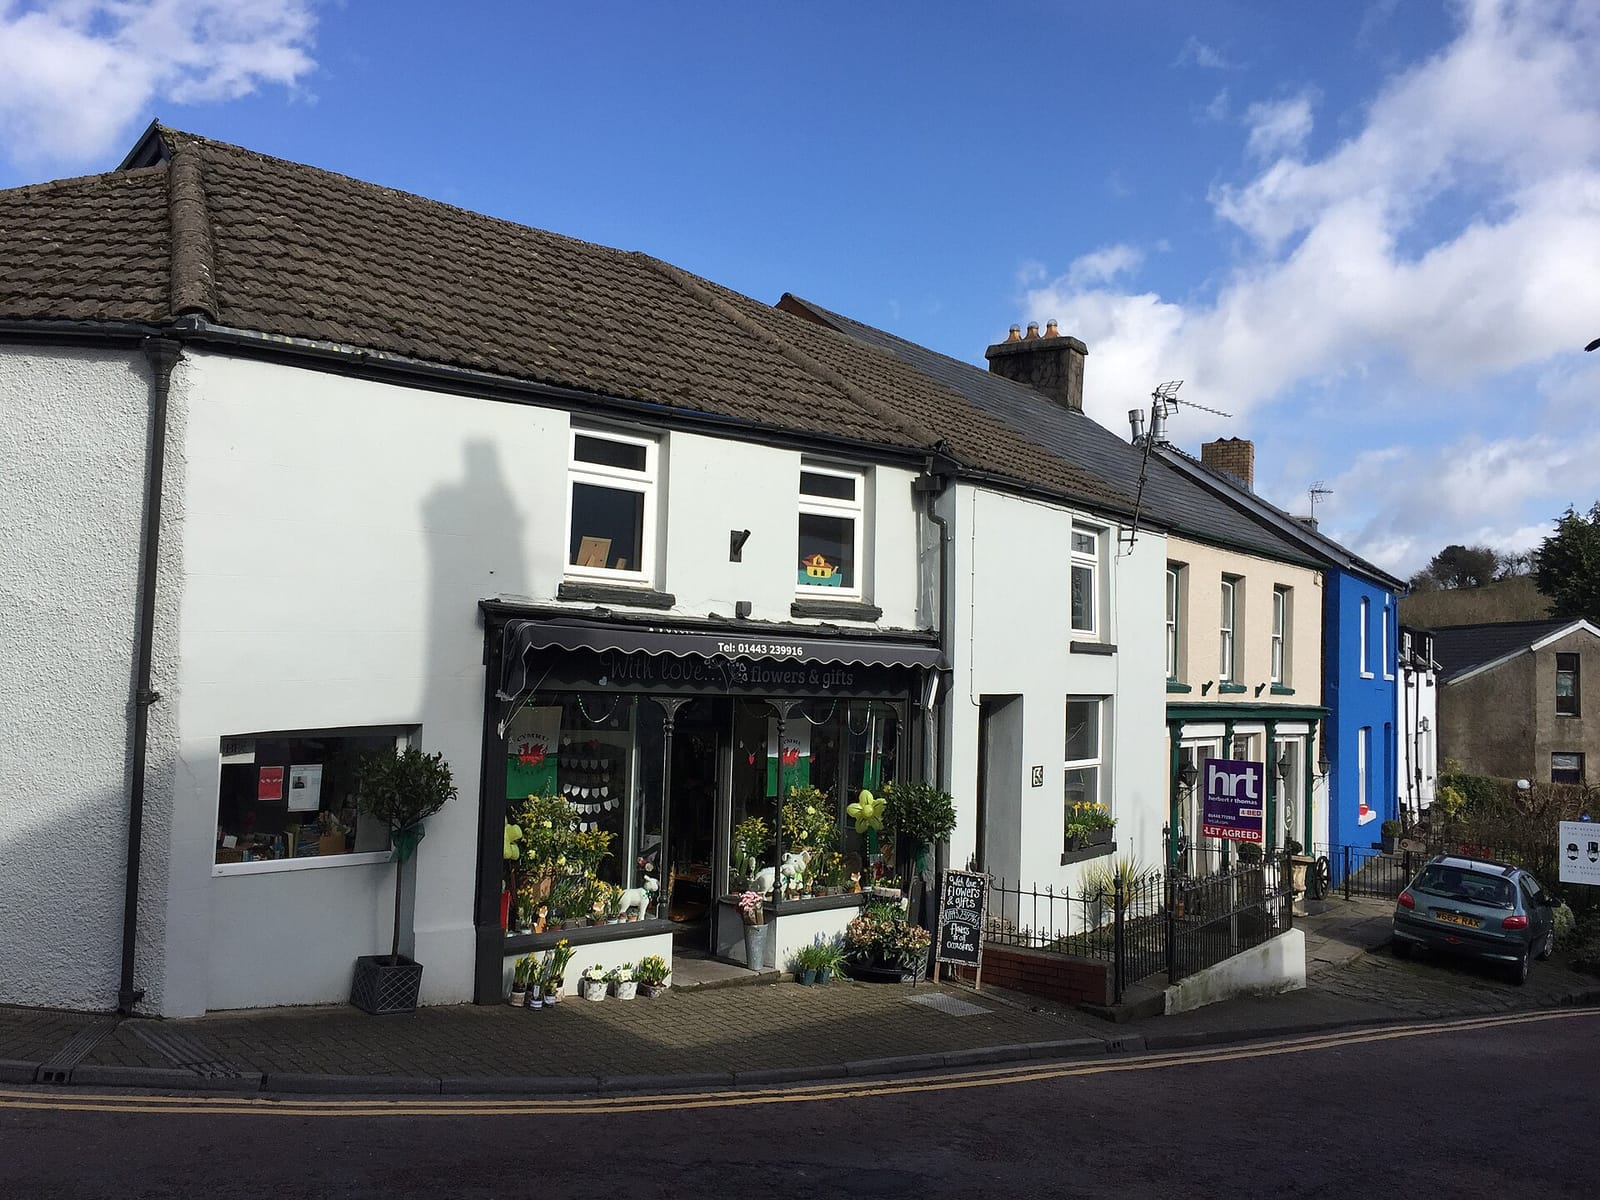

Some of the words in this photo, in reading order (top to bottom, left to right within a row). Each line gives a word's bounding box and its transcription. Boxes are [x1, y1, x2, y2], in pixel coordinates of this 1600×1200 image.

[718, 642, 736, 653] Tel:
[738, 643, 767, 654] 01443
[769, 645, 803, 656] 239916
[750, 666, 806, 684] flowers
[808, 669, 820, 685] &
[822, 669, 854, 689] gifts
[1208, 764, 1258, 798] hrt
[1234, 797, 1258, 805] thomas
[1204, 826, 1221, 835] LET
[1222, 829, 1259, 840] AGREED
[947, 886, 980, 898] flowers
[947, 896, 954, 905] &
[955, 896, 976, 909] gifts
